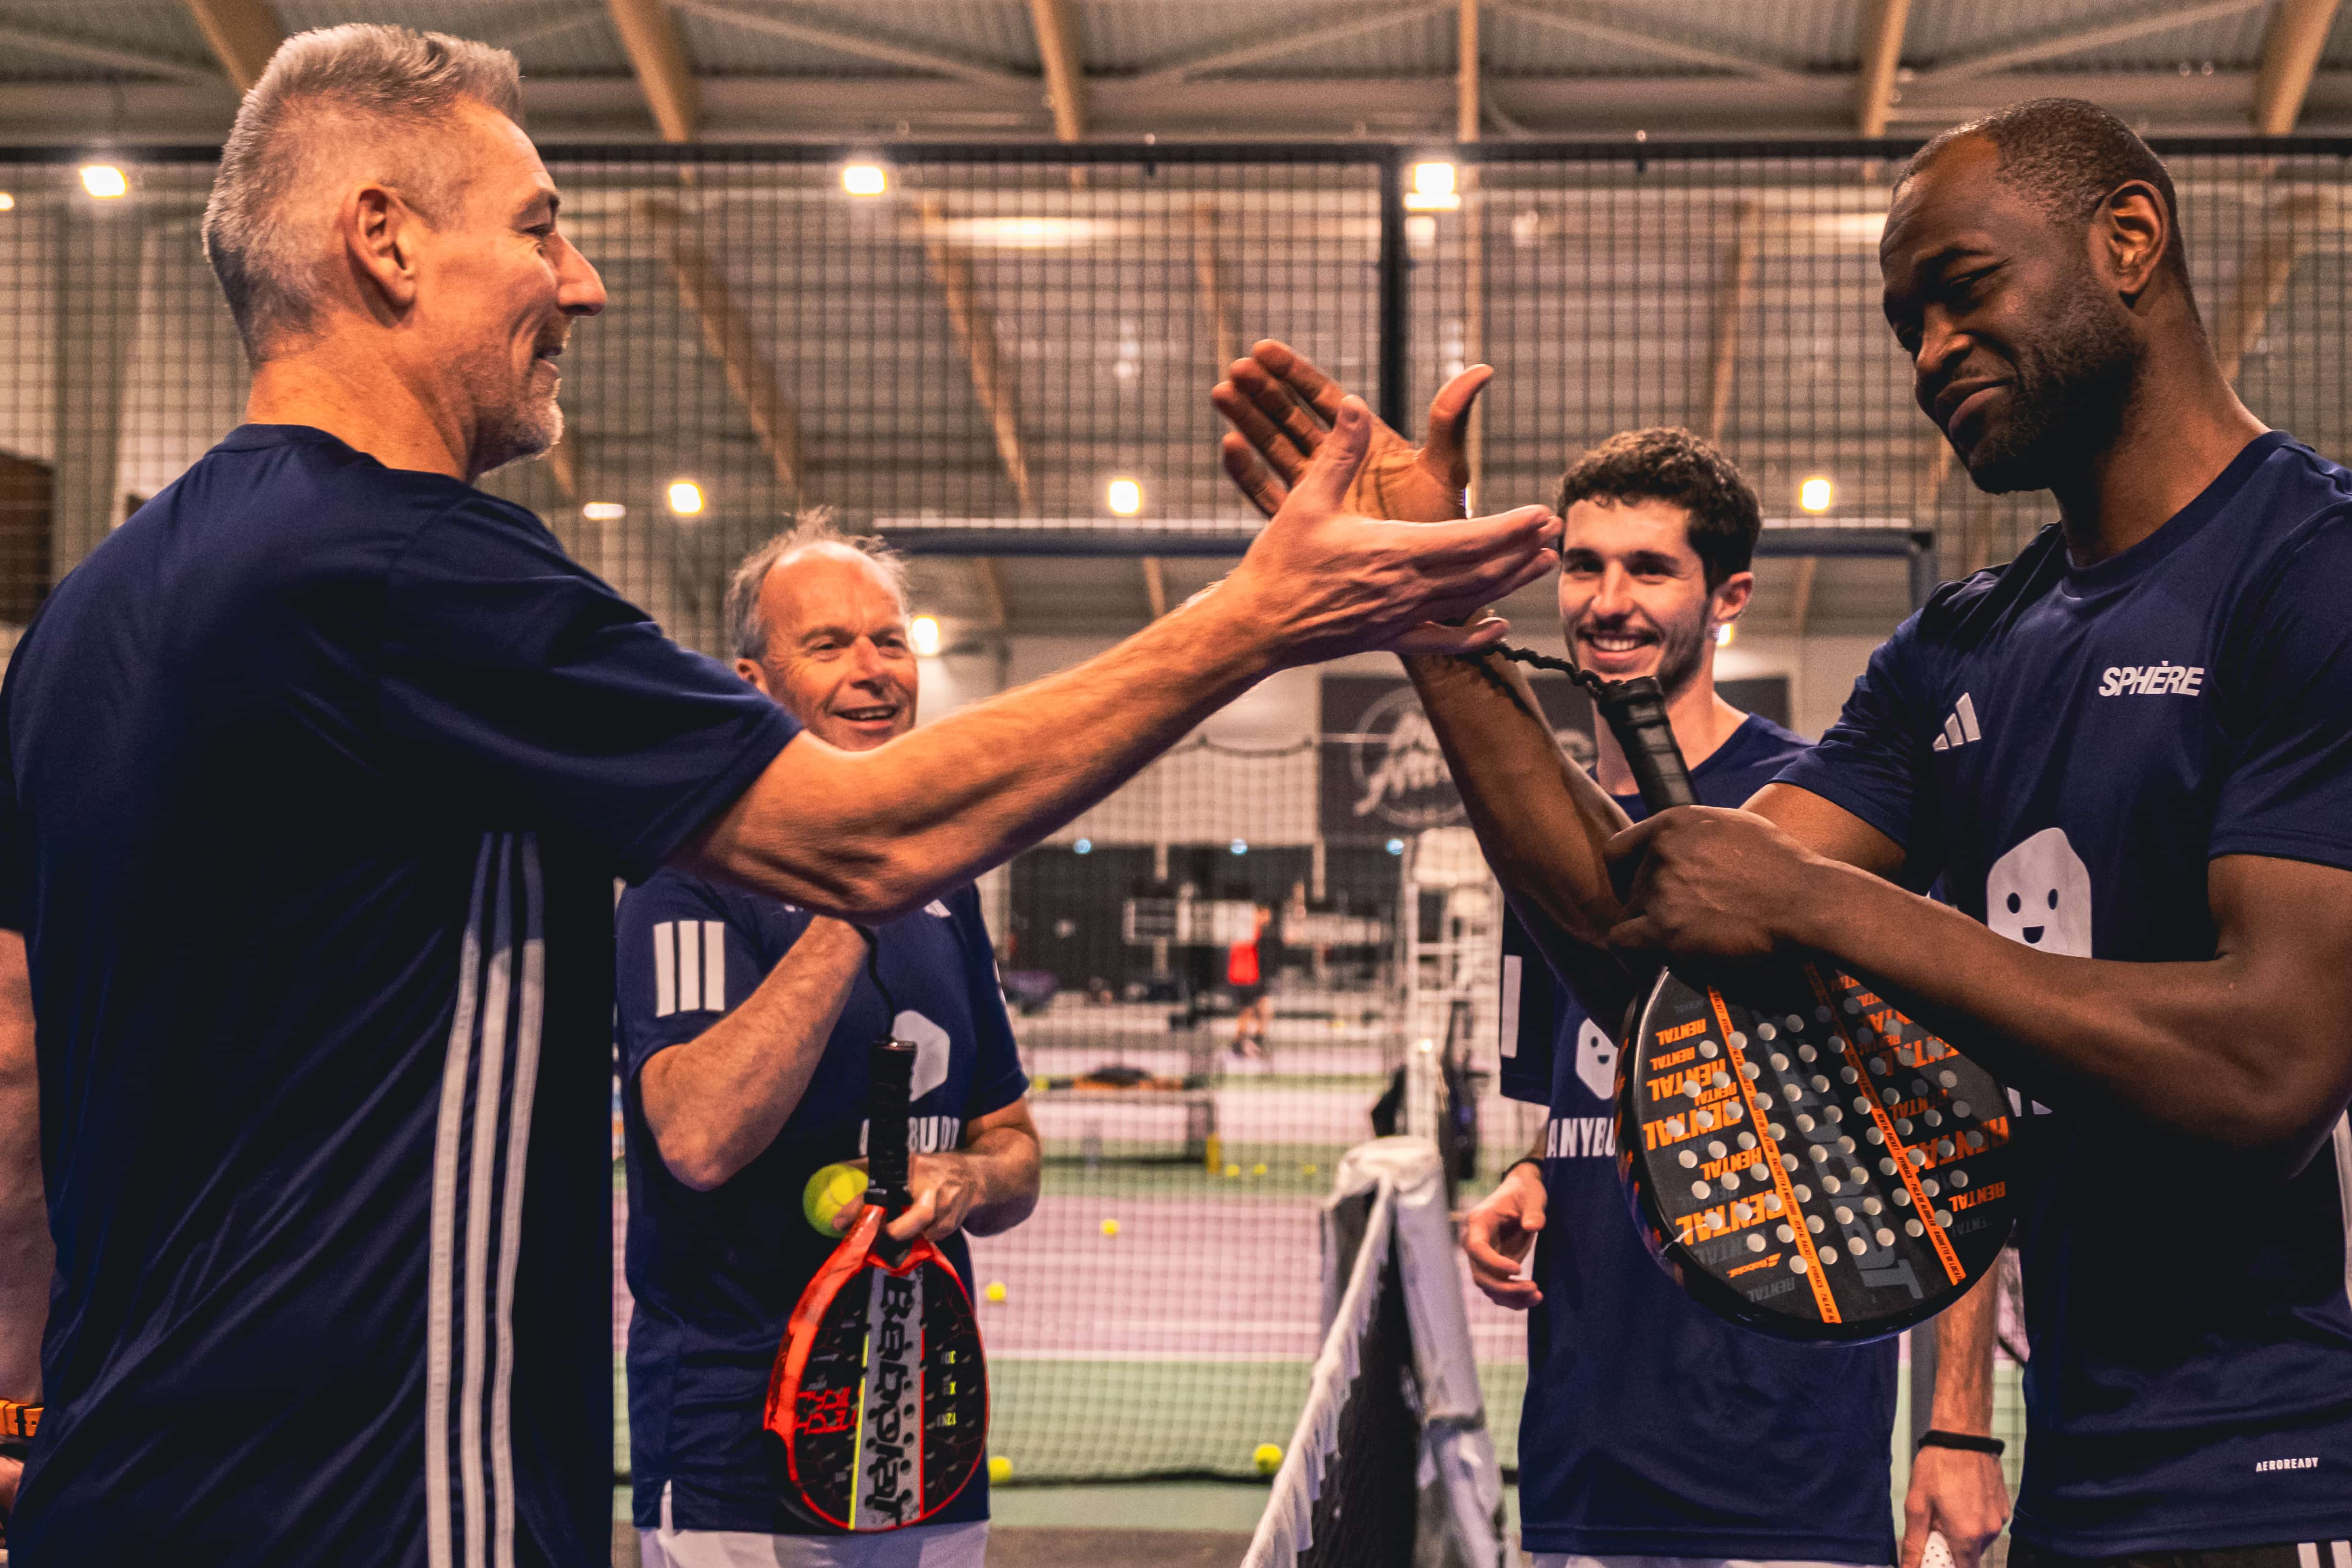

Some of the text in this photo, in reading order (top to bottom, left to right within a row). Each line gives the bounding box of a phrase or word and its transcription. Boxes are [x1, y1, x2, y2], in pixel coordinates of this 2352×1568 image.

[1655, 1019, 1706, 1045] RENTAL
[1650, 1047, 1695, 1071] RENTAL
[1646, 1059, 1726, 1101] RENTAL
[1695, 1082, 1737, 1106] RENTAL
[1643, 1096, 1742, 1151] RENTAL
[1699, 1147, 1762, 1180] RENTAL
[1948, 1181, 2006, 1212] RENTAL
[1675, 1190, 1787, 1246] RENTAL
[2255, 1457, 2319, 1472] AEROREADY
